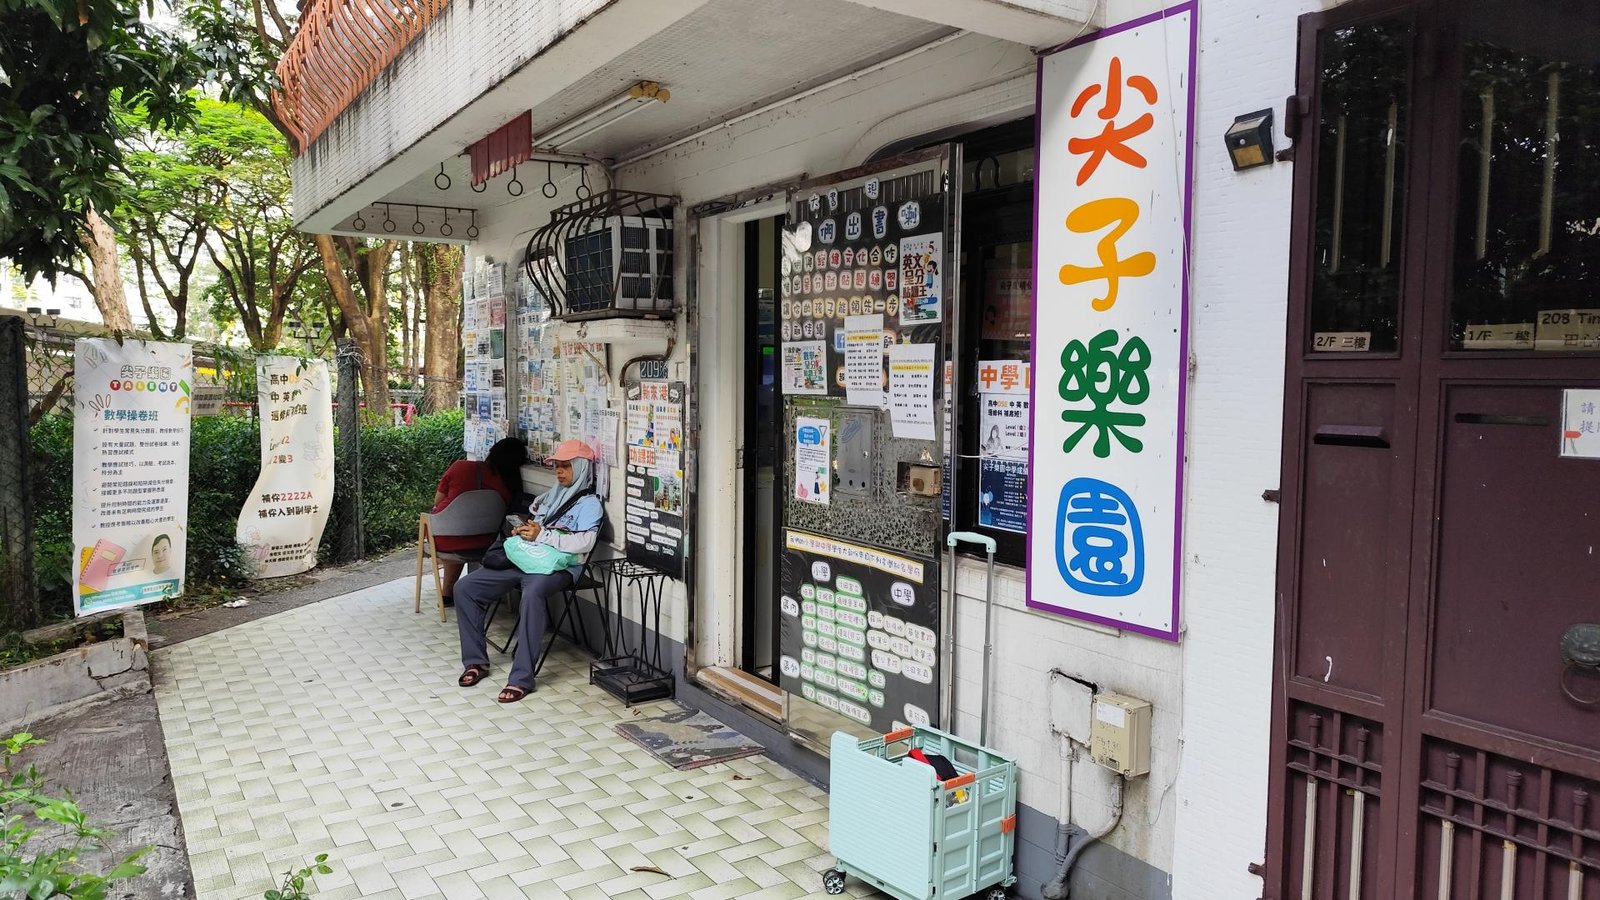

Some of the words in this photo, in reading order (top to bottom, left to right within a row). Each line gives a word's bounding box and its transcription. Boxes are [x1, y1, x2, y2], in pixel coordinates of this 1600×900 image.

[903, 253, 923, 270] 英文
[904, 269, 925, 285] 呈分
[1542, 313, 1571, 324] 208
[1056, 56, 1158, 597] 尖子樂園
[1317, 337, 1337, 347] 2/F
[1341, 336, 1366, 348] 三樓
[1469, 331, 1492, 340] 1/F
[980, 365, 1030, 390] 中學
[110, 380, 178, 392] TALENT
[104, 409, 159, 421] 數學操卷班
[1581, 402, 1595, 415] 請
[1579, 420, 1600, 433] 提
[261, 491, 313, 503] 補你2222A
[813, 563, 829, 578] 小學
[893, 586, 913, 603] 中學
